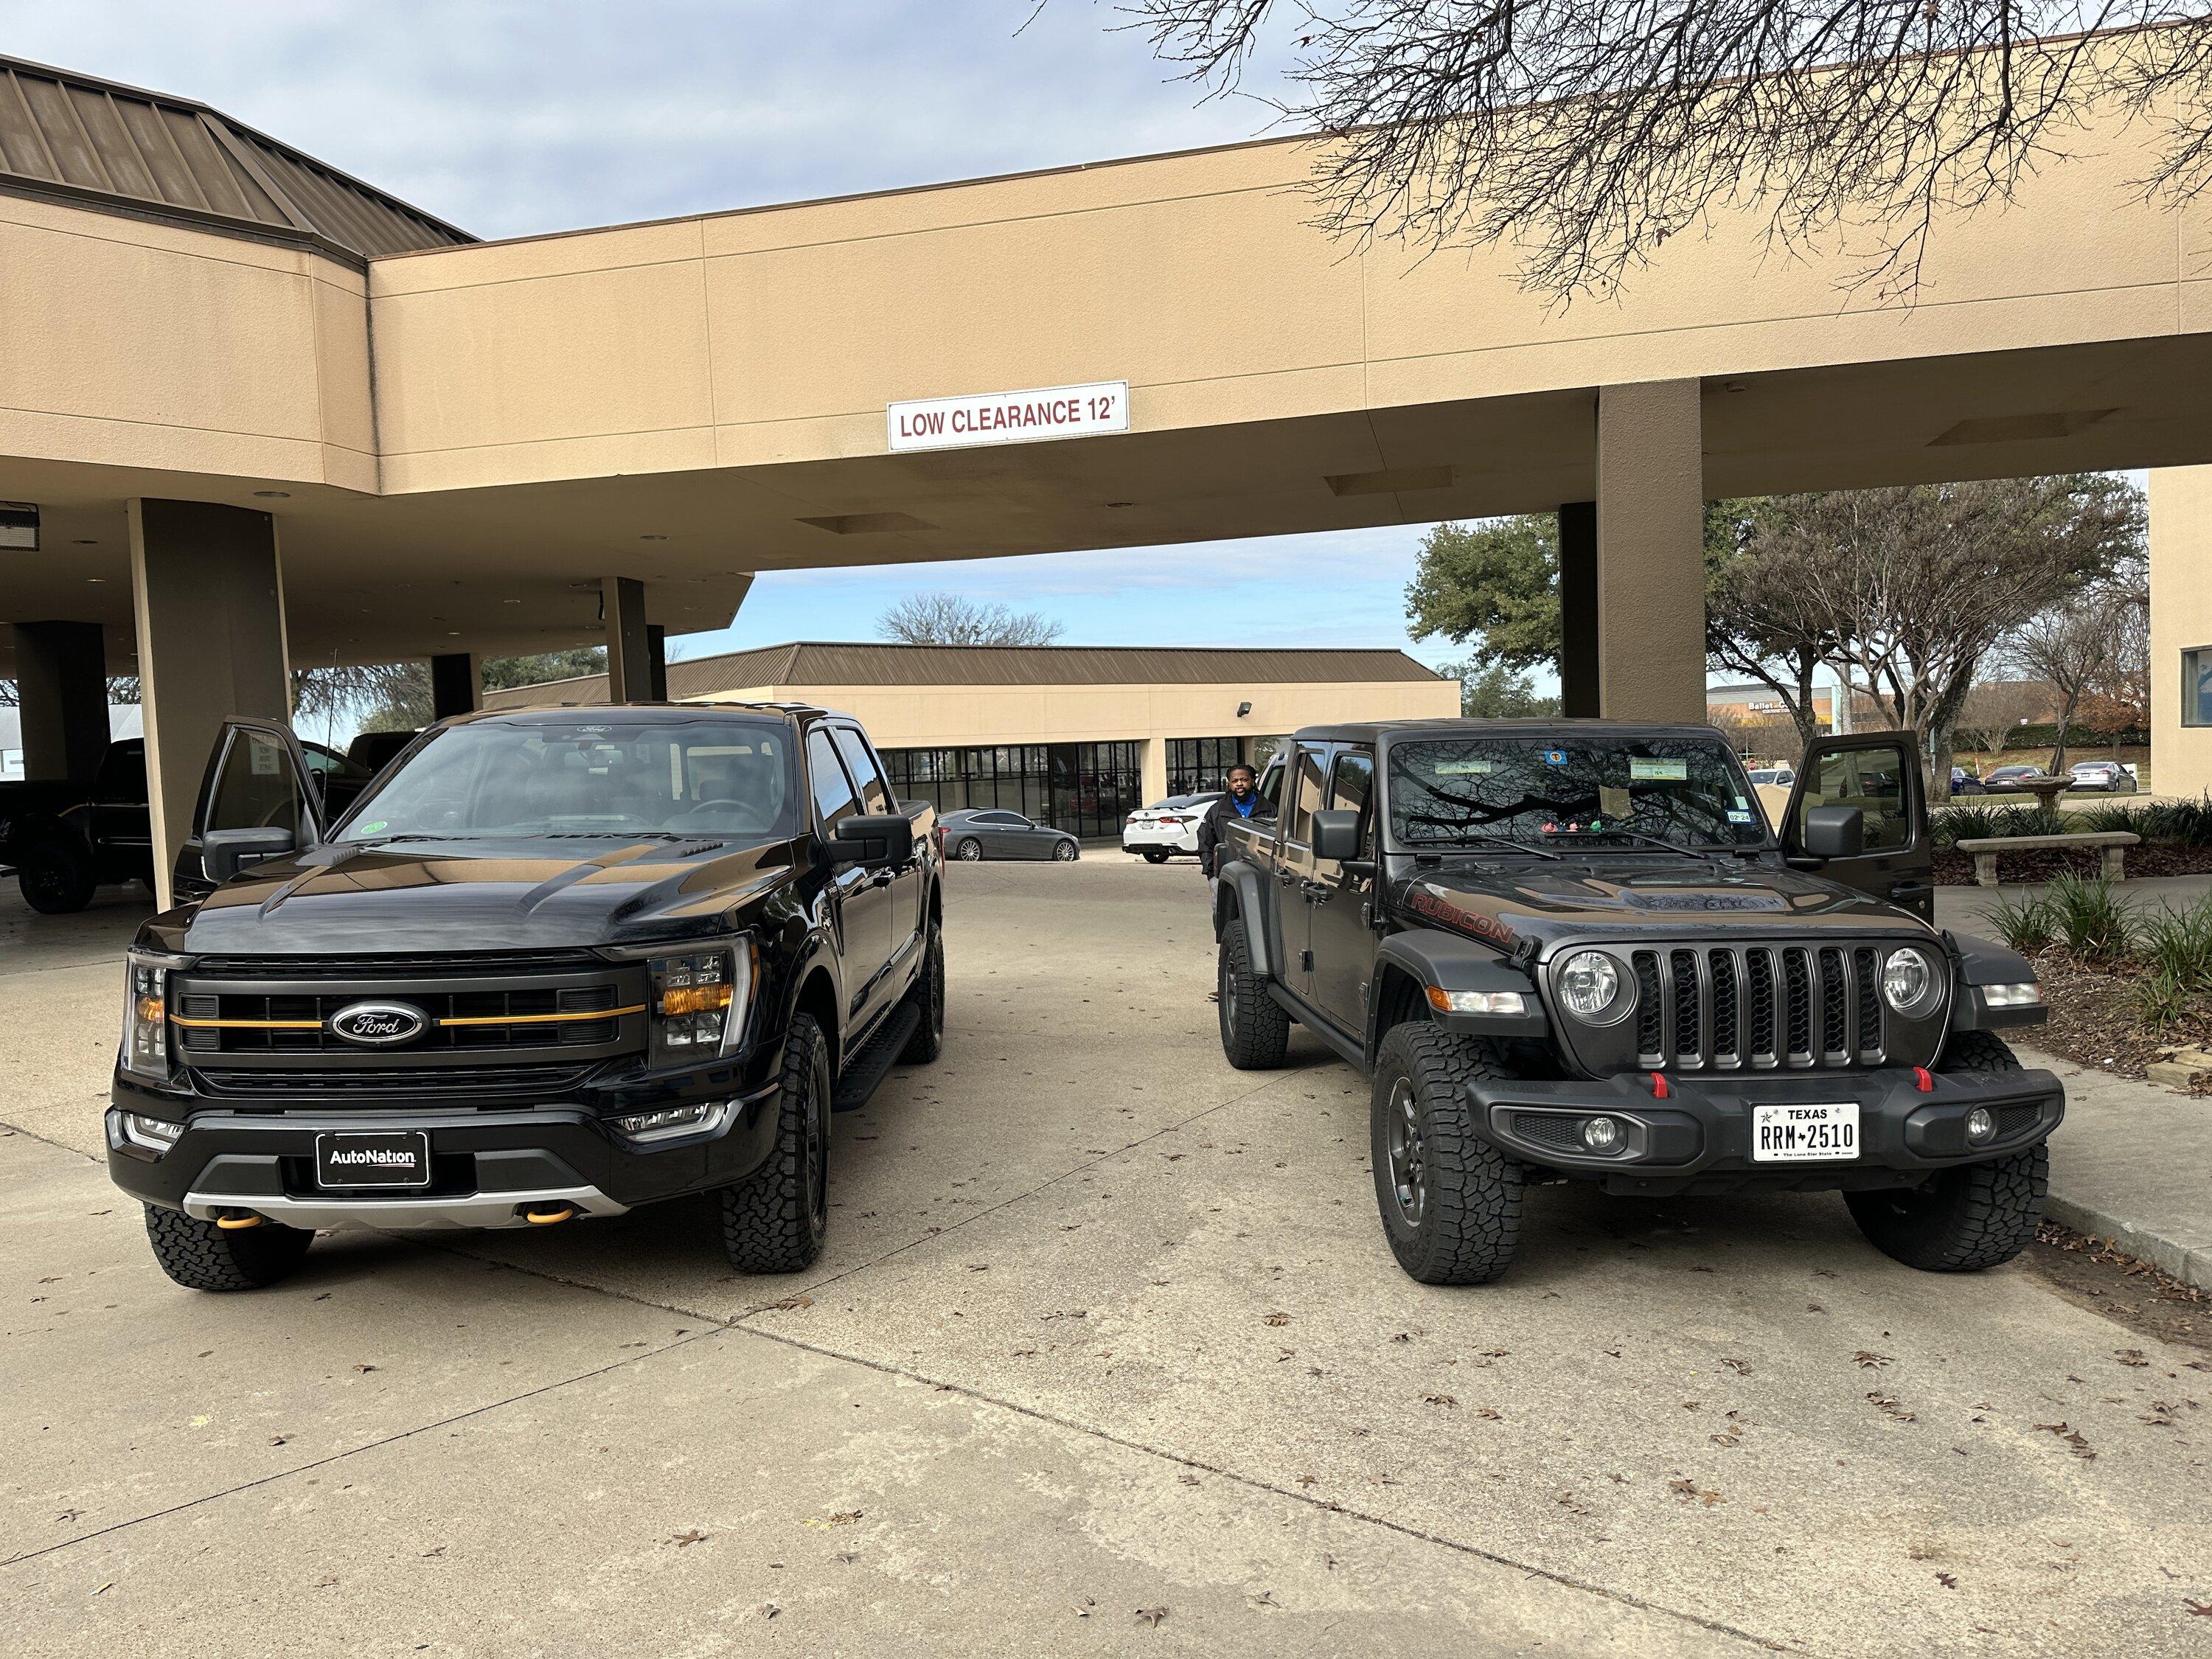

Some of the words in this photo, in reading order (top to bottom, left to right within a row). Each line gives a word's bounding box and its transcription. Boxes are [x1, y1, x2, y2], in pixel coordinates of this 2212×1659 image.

[900, 411, 945, 437] LOW
[951, 399, 1081, 434] CLEARANCE
[1088, 395, 1116, 421] 12'
[1748, 702, 1773, 710] Ballet
[1411, 893, 1515, 943] RUBICON
[352, 1013, 399, 1034] Ford
[1787, 1109, 1827, 1120] TEXAS
[330, 1150, 415, 1164] AutoNation
